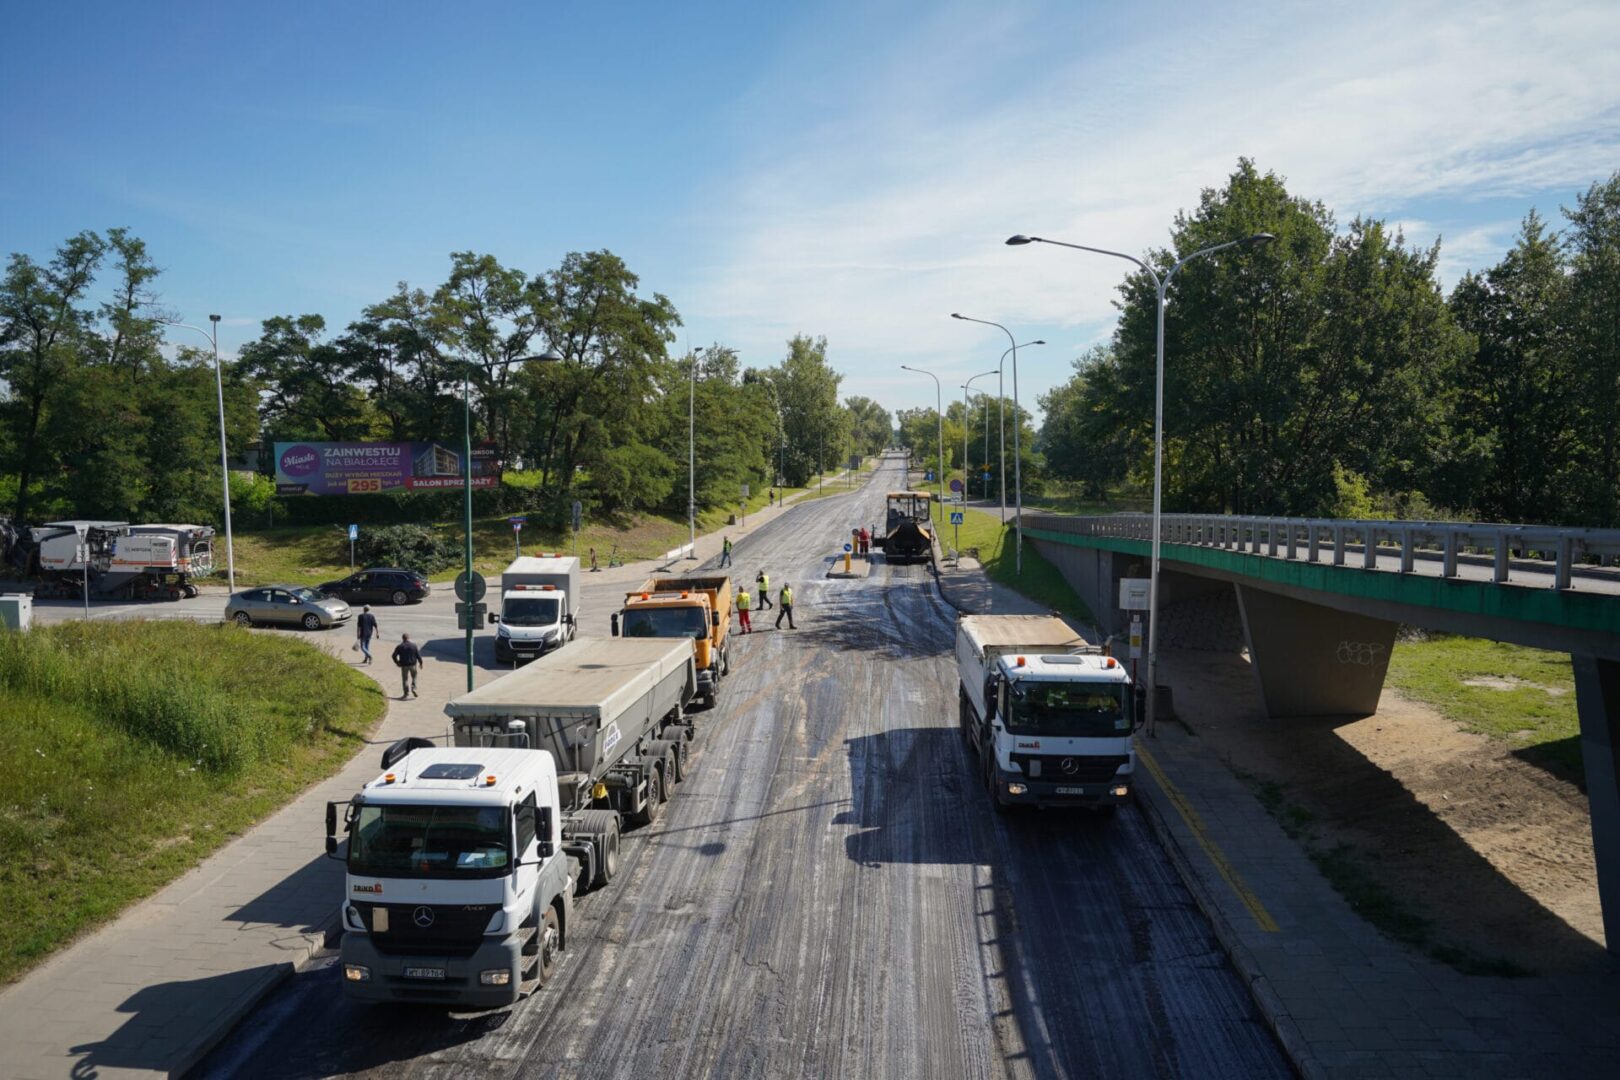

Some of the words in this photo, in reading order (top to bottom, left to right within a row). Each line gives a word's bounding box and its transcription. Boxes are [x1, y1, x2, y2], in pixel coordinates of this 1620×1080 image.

[324, 447, 400, 457] ZAINWESTUJ
[284, 452, 315, 467] Miasto
[326, 457, 342, 466] NA
[344, 457, 400, 467] BIAŁOŁĘCE
[351, 480, 379, 492] 295
[443, 478, 492, 487] SPRZDAŻY
